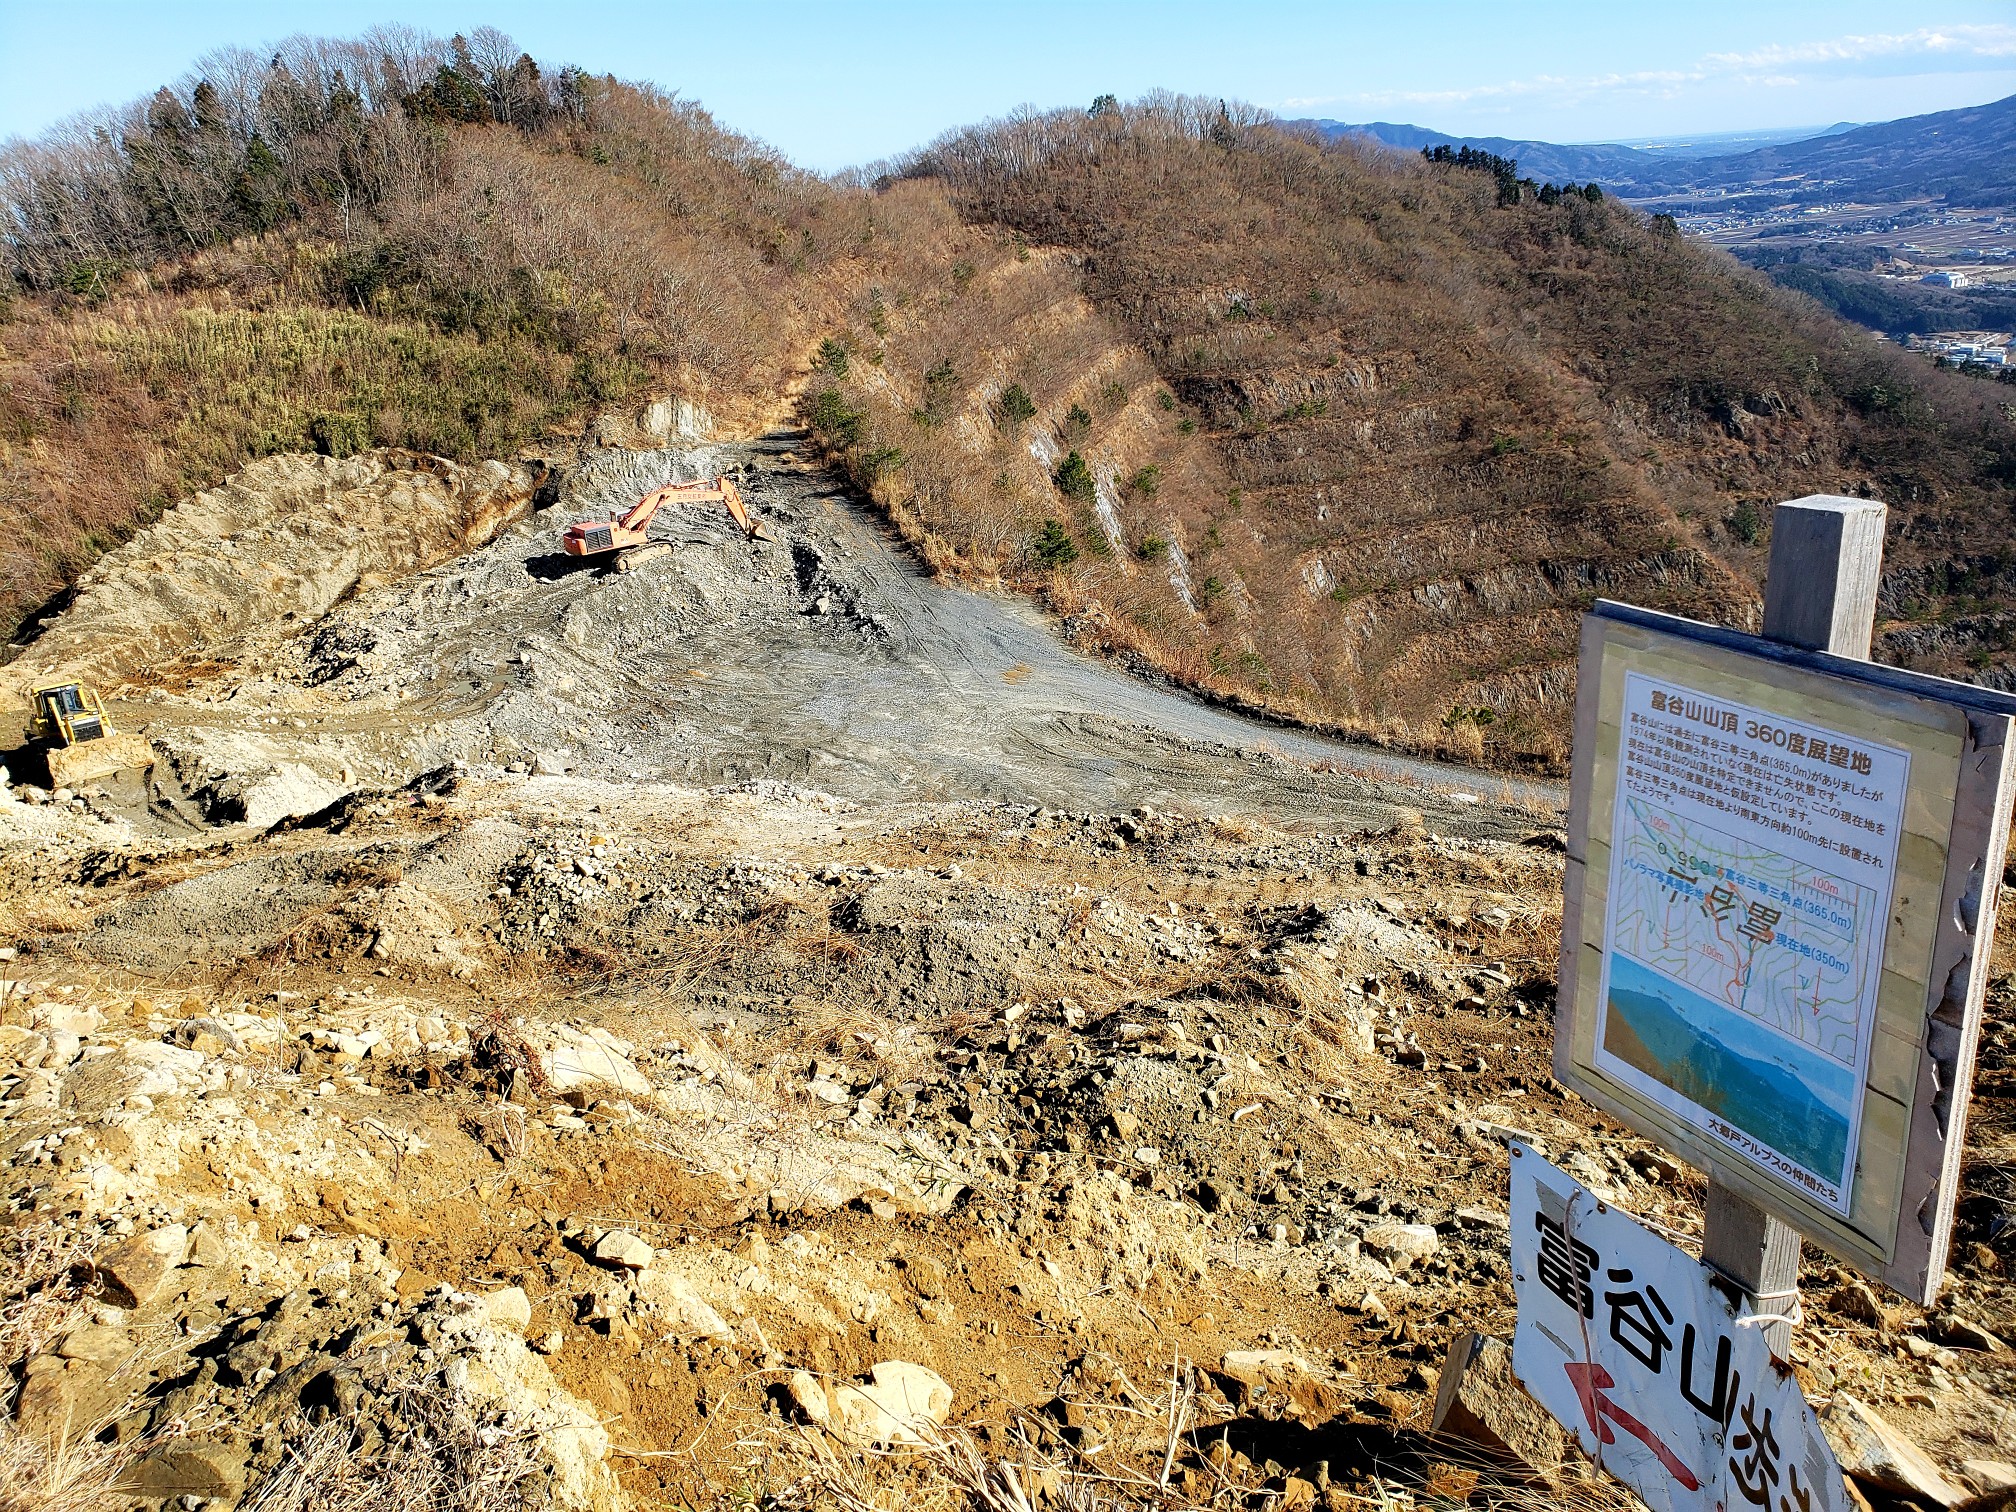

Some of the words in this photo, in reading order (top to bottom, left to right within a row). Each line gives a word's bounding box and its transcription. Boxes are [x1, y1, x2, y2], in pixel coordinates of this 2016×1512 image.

[1651, 690, 1739, 735] 富谷山山頂
[1744, 720, 1873, 776] 360度展望地
[1812, 876, 1839, 895] 100m
[1702, 943, 1724, 962] 100m
